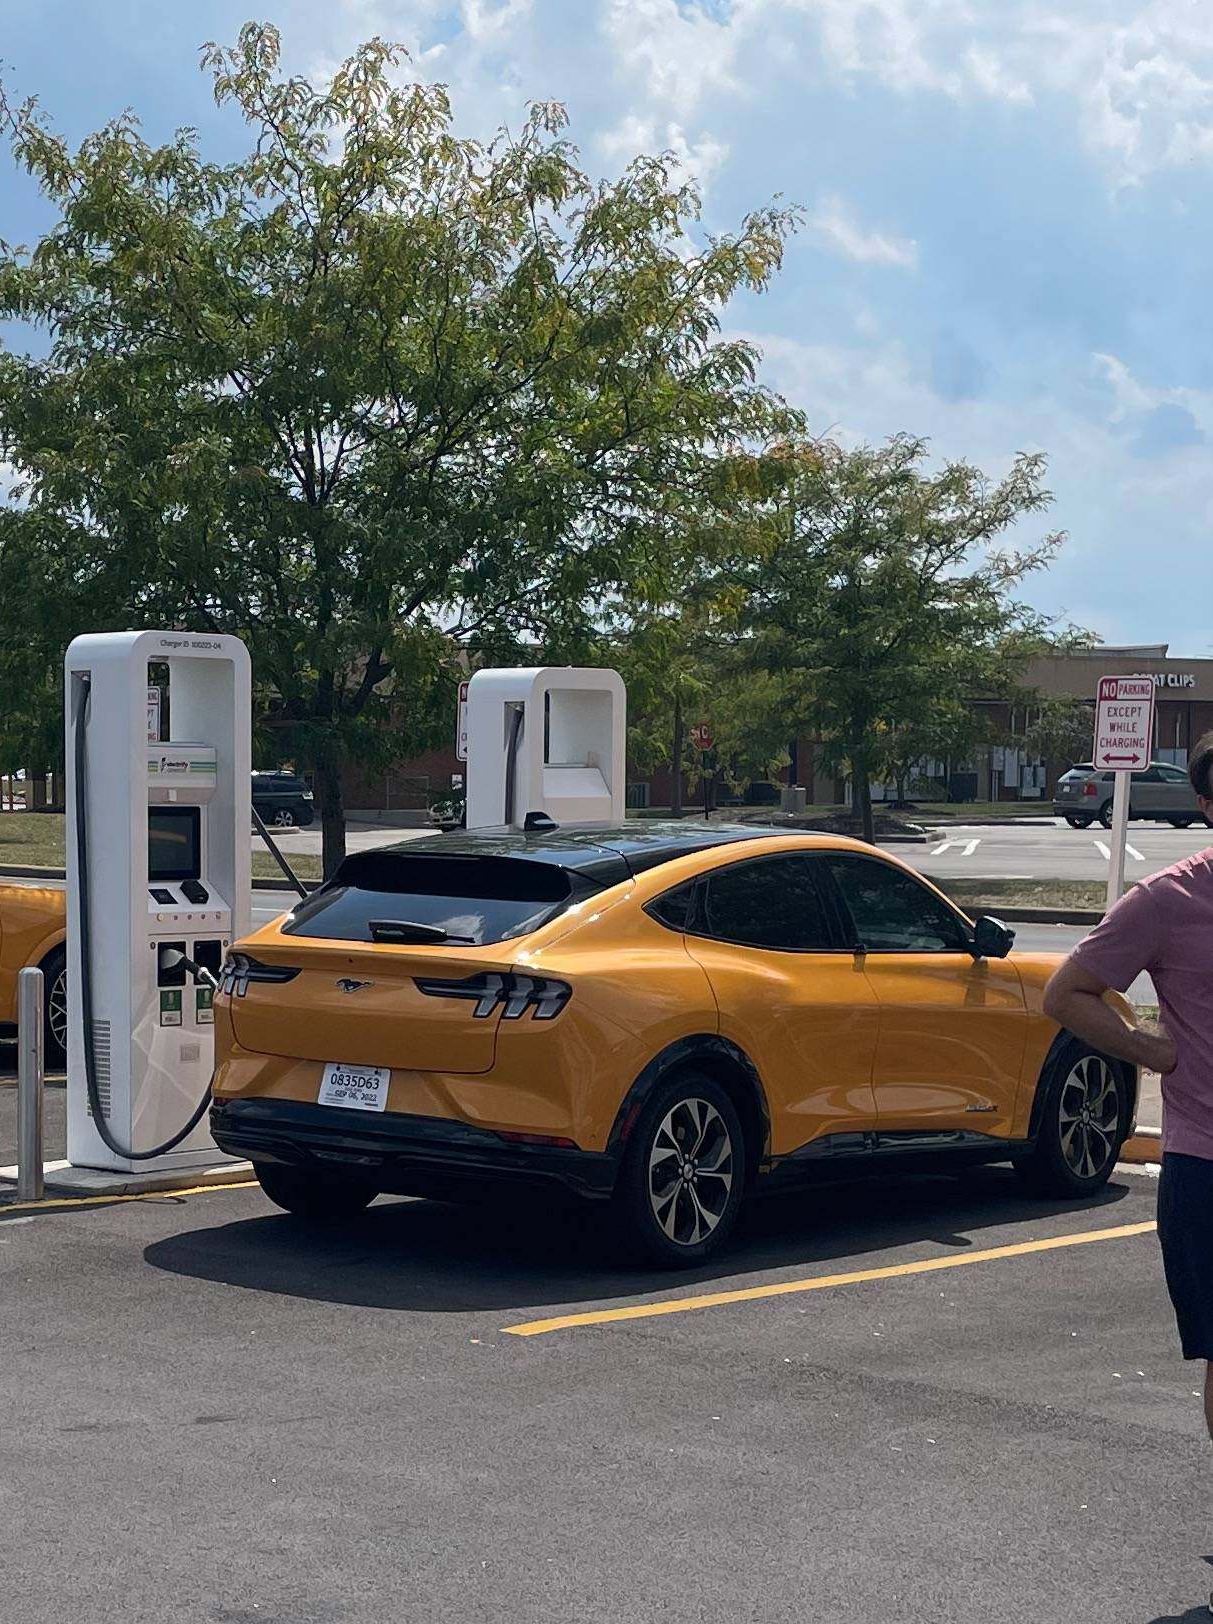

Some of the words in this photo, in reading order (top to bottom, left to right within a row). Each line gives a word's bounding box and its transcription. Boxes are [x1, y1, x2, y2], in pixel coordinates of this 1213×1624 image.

[160, 639, 182, 649] Charger
[183, 640, 190, 648] ID
[1168, 673, 1195, 688] CLIPS
[1102, 682, 1117, 697] NO
[1118, 683, 1150, 696] PARKING
[1107, 707, 1142, 718] EXCEPT
[1109, 722, 1138, 733] WHILE
[1099, 737, 1145, 749] CHARGING
[330, 1073, 380, 1090] 0835D63
[335, 1089, 348, 1098] SEP
[361, 1092, 378, 1102] 2022
